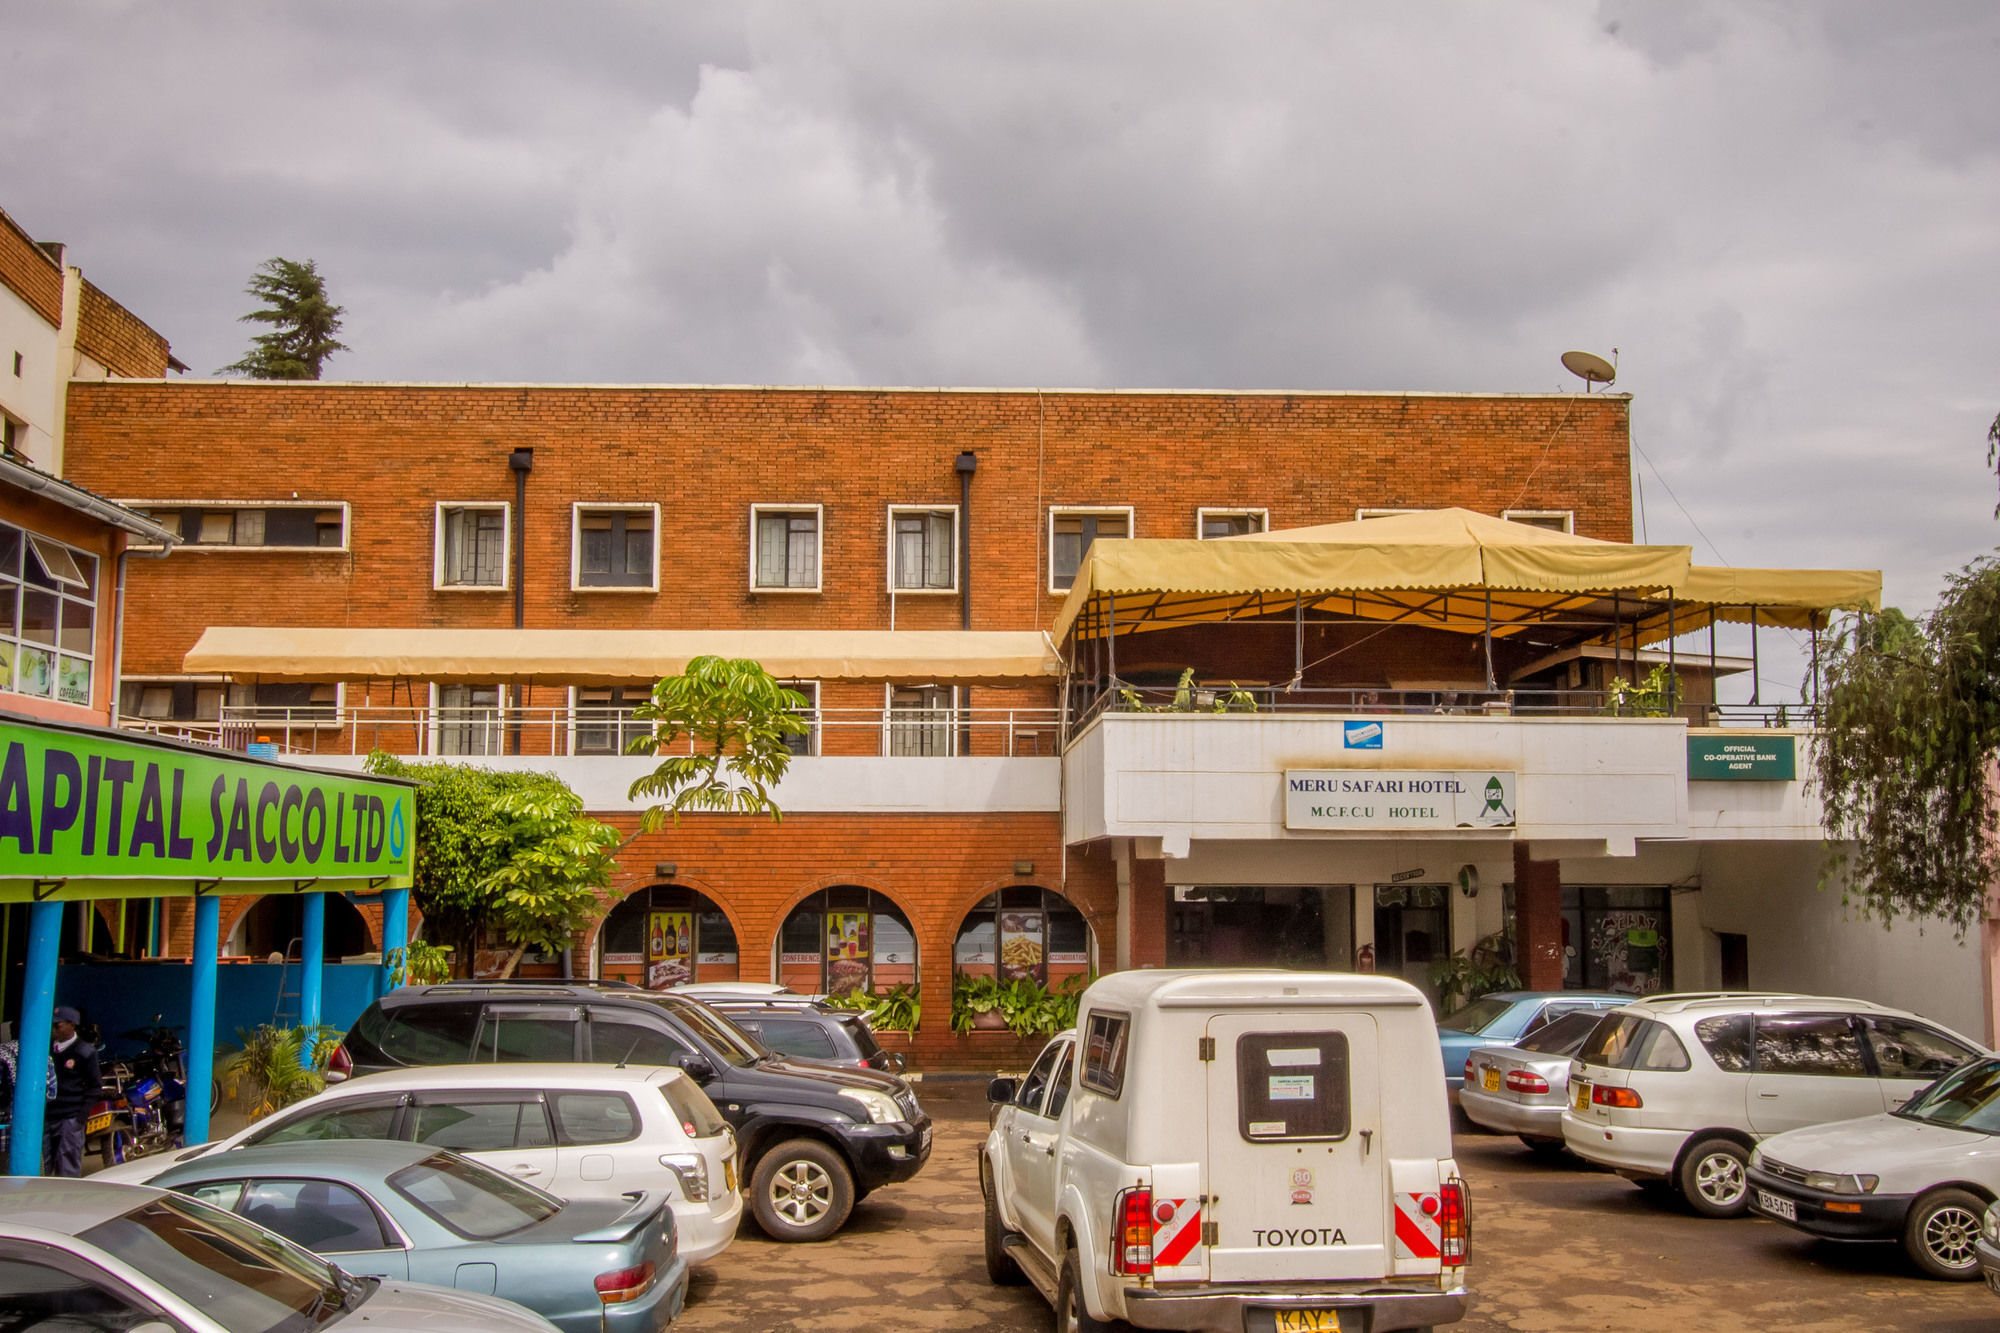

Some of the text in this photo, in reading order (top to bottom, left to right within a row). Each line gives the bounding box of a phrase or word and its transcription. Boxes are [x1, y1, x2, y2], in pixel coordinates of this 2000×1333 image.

[1723, 745, 1757, 753] OFFICIAL
[1728, 762, 1753, 770] AGENT
[1289, 779, 1466, 794] MERU SAFARI HOTEL
[206, 773, 326, 865] SACCO
[334, 791, 385, 863] LTD
[1389, 807, 1440, 818] HOTEL
[782, 953, 820, 962] CONFERENCE
[1295, 1171, 1310, 1184] 80
[1252, 1229, 1347, 1246] TOYOTA
[1281, 1309, 1322, 1331] KAY
